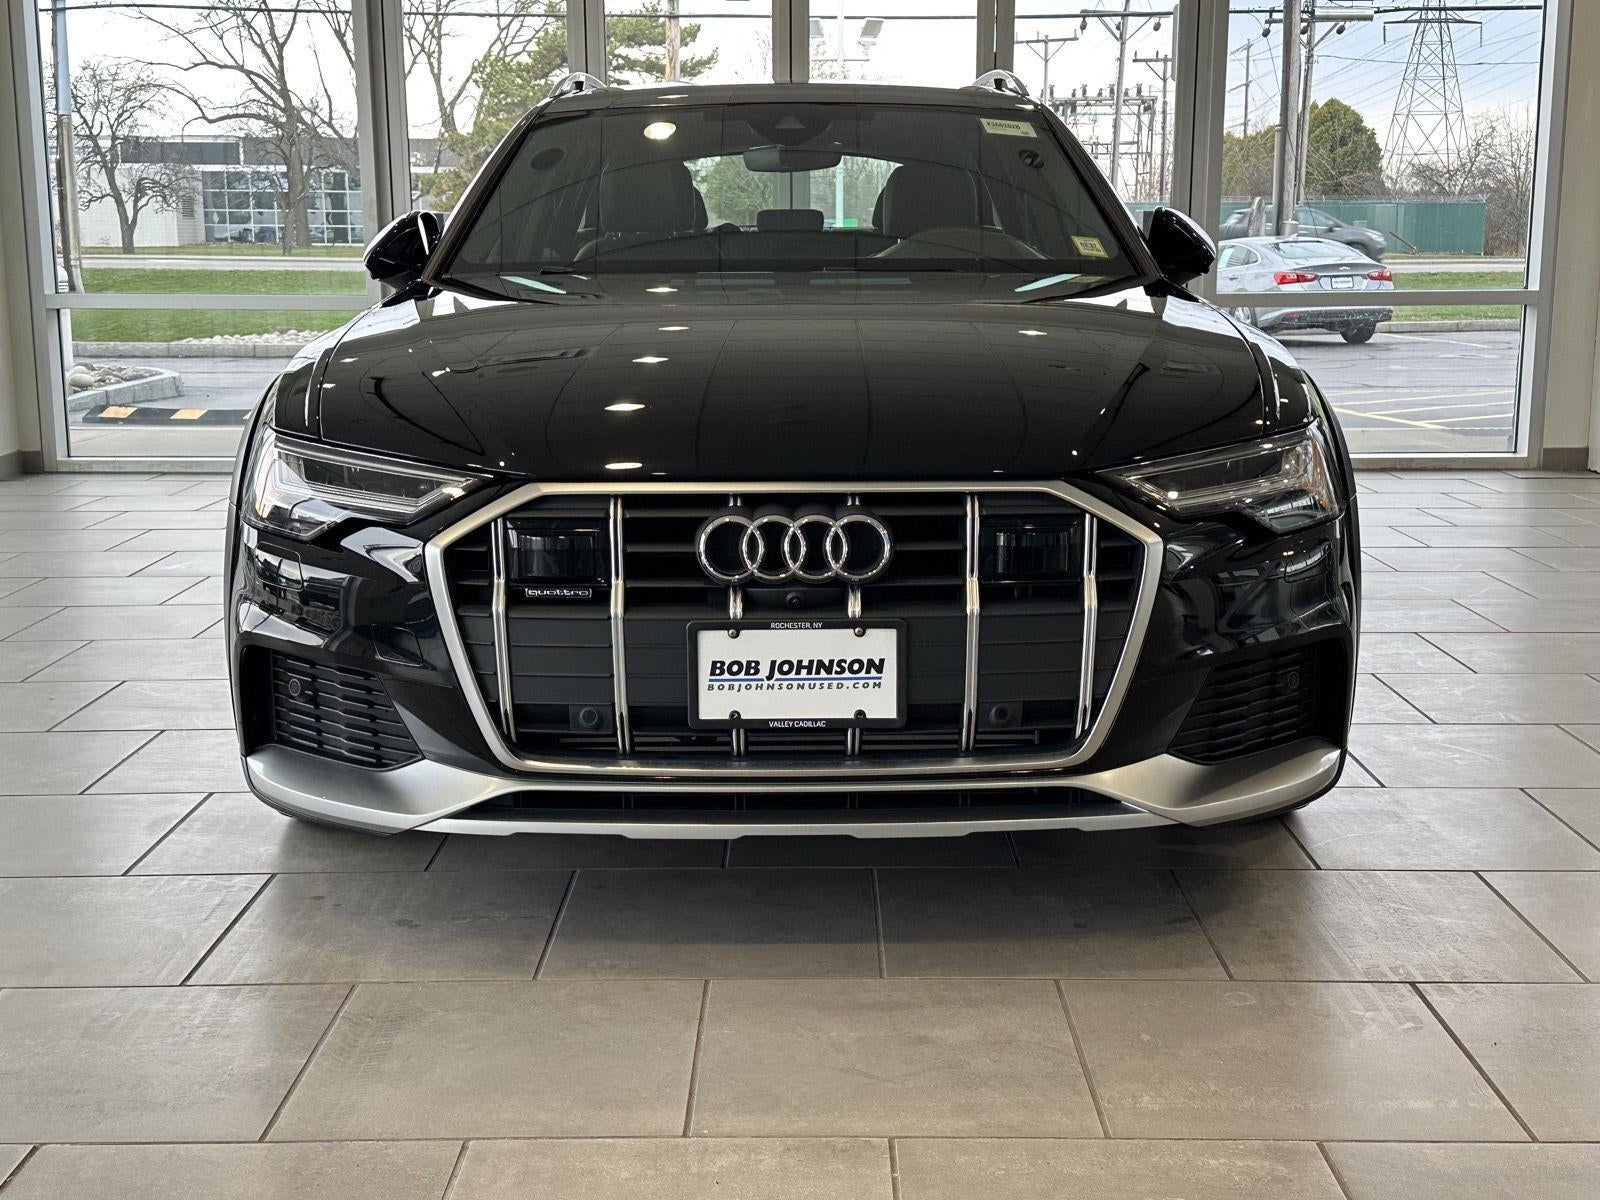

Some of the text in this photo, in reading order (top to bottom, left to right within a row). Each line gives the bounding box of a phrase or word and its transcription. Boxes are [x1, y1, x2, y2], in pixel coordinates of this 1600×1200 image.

[528, 588, 589, 597] quattro
[710, 658, 885, 681] BOB JOHNSON
[707, 682, 882, 692] BOBJOHNSONUSED.COM
[768, 720, 826, 728] VALLEY CADILLAC
